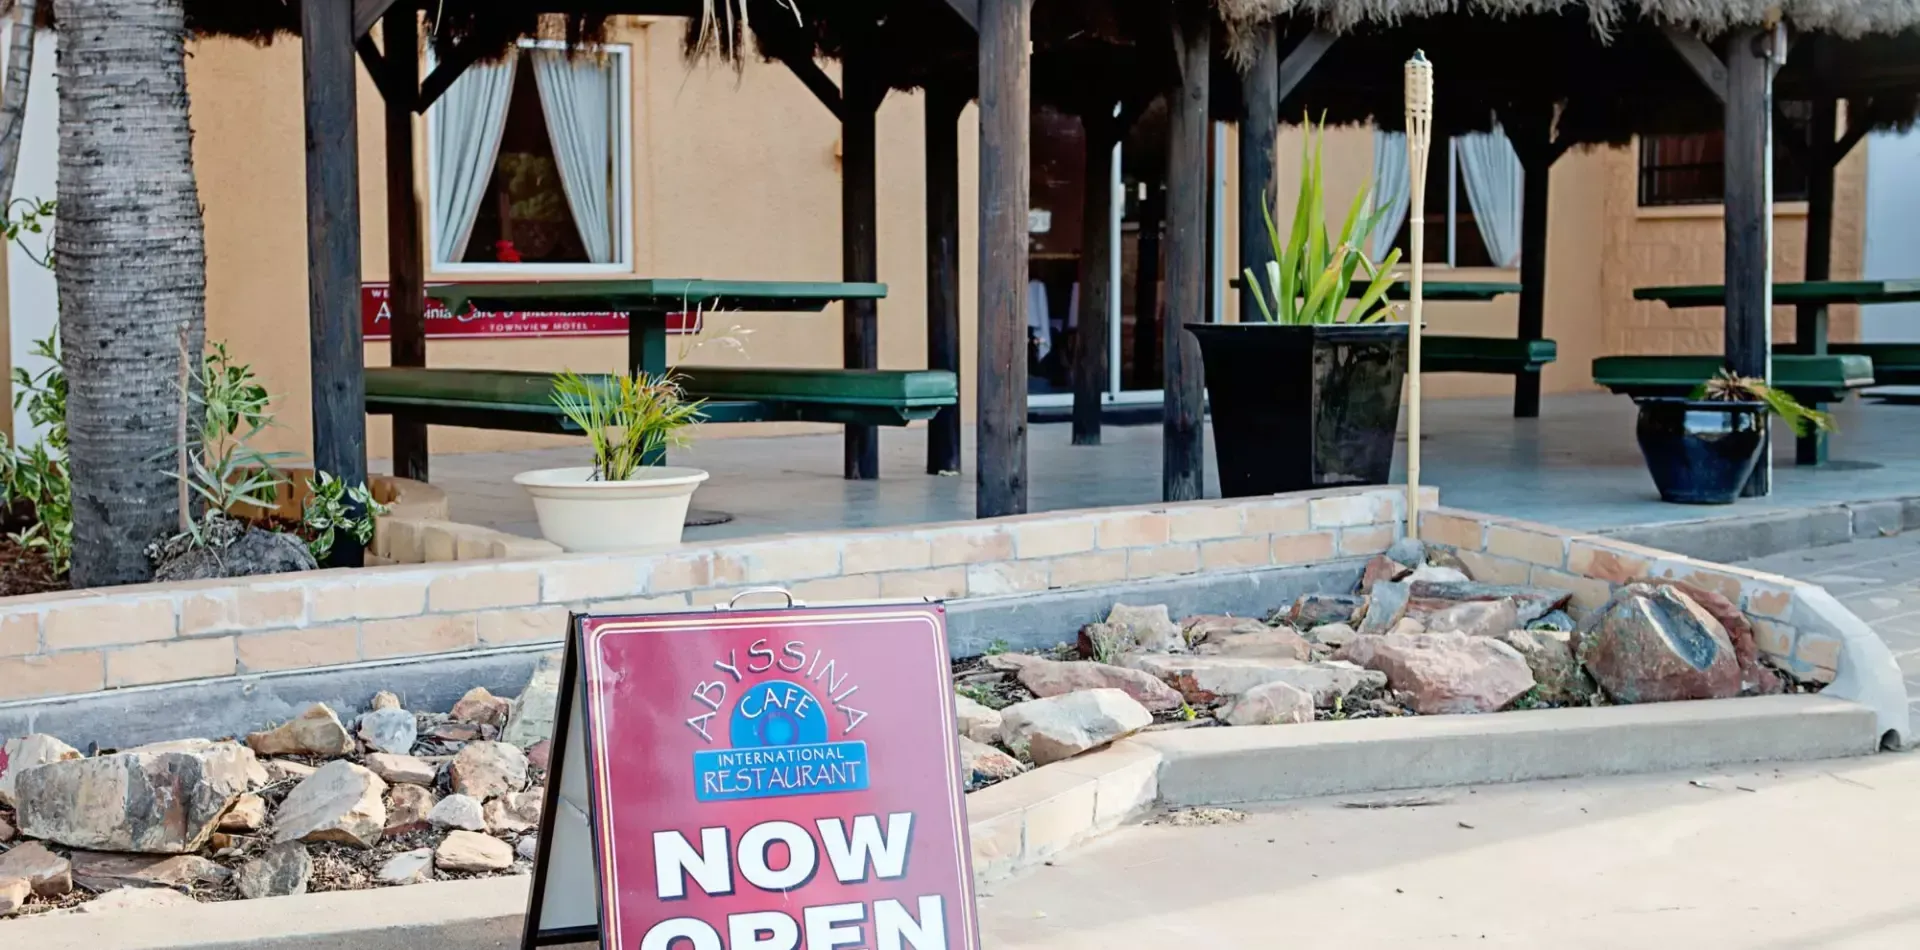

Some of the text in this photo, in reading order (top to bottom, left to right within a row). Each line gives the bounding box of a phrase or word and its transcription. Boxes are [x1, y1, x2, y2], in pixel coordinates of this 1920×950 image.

[489, 322, 588, 332] TOWNVIEW MOTEL
[686, 638, 868, 743] ABYSSINIA
[740, 687, 813, 719] CAFE
[718, 747, 845, 767] INTERNATIONAL
[704, 761, 861, 793] RESTAURANT
[652, 811, 912, 899] NOW
